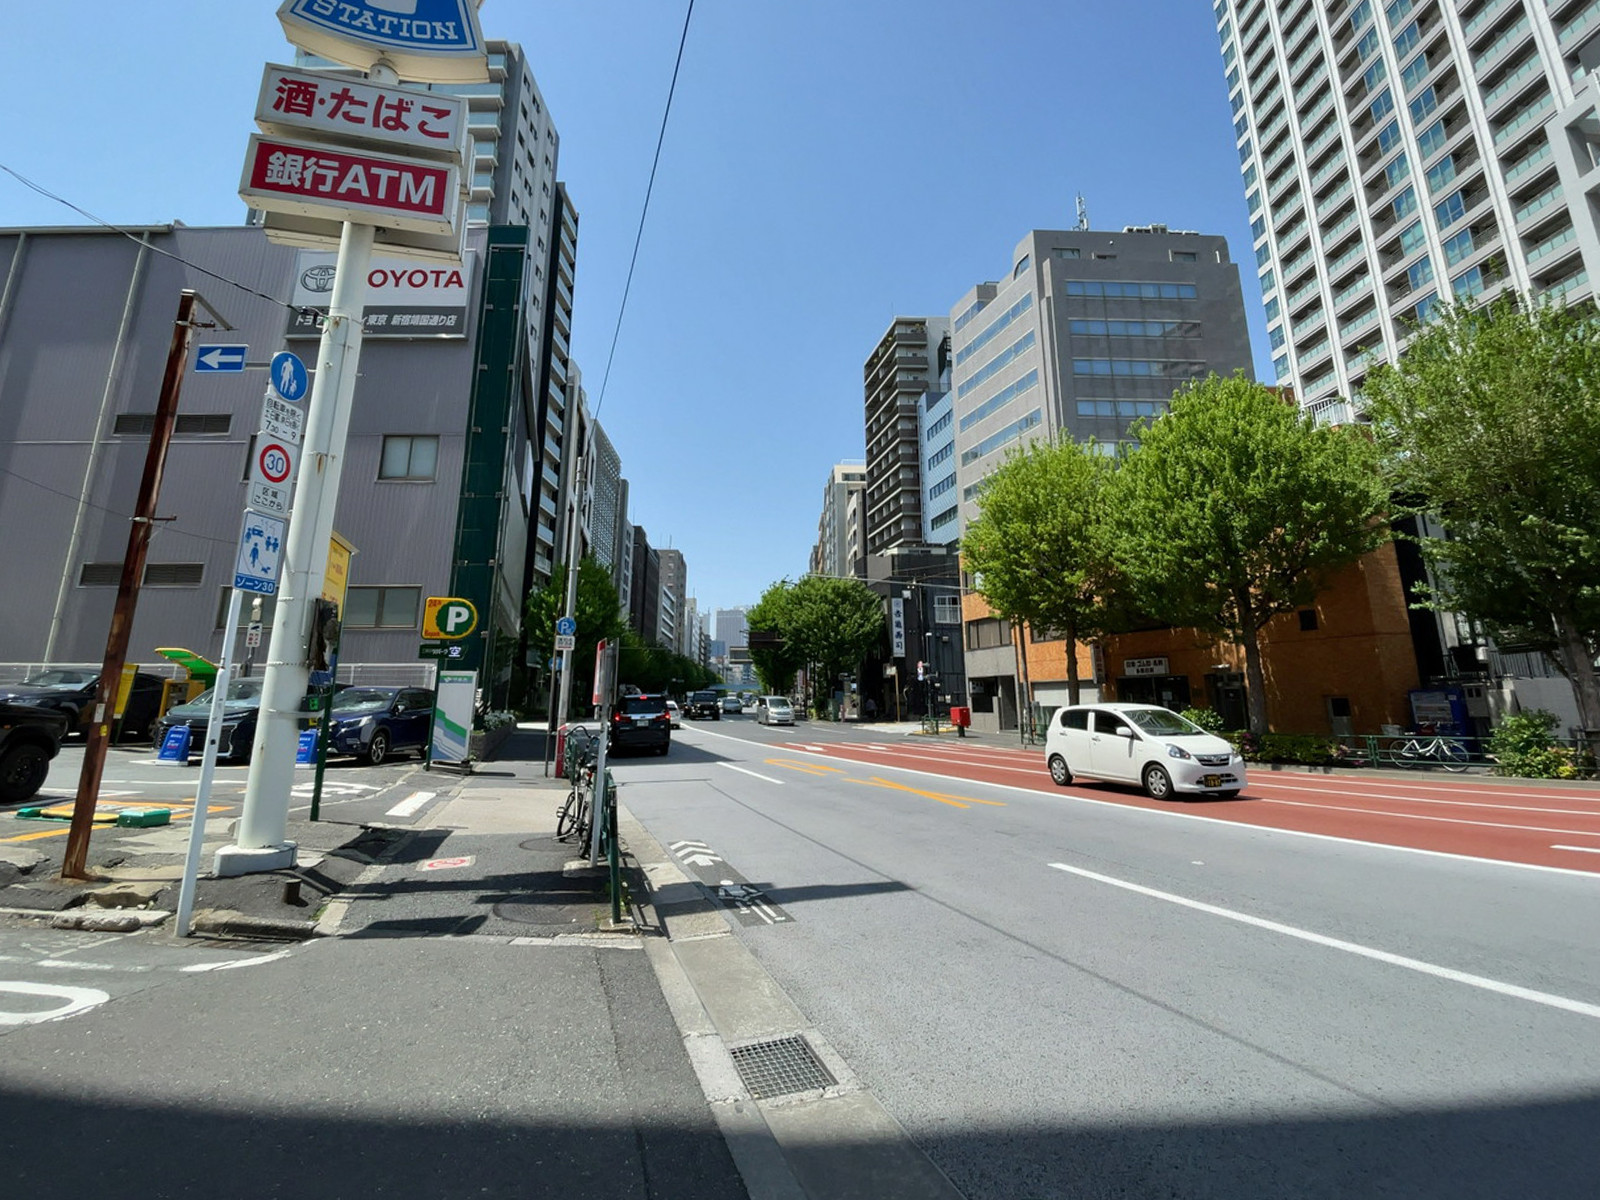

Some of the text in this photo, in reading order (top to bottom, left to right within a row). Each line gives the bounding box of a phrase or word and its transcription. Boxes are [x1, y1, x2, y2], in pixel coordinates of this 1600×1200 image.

[313, 0, 459, 40] STATION
[272, 77, 451, 139] 酒・たばこ
[265, 151, 435, 207] 銀行ATM
[367, 269, 464, 288] OYOTA
[266, 454, 285, 474] 30
[253, 494, 283, 511] ここから
[237, 577, 274, 593] ゾーン30
[446, 606, 470, 632] P
